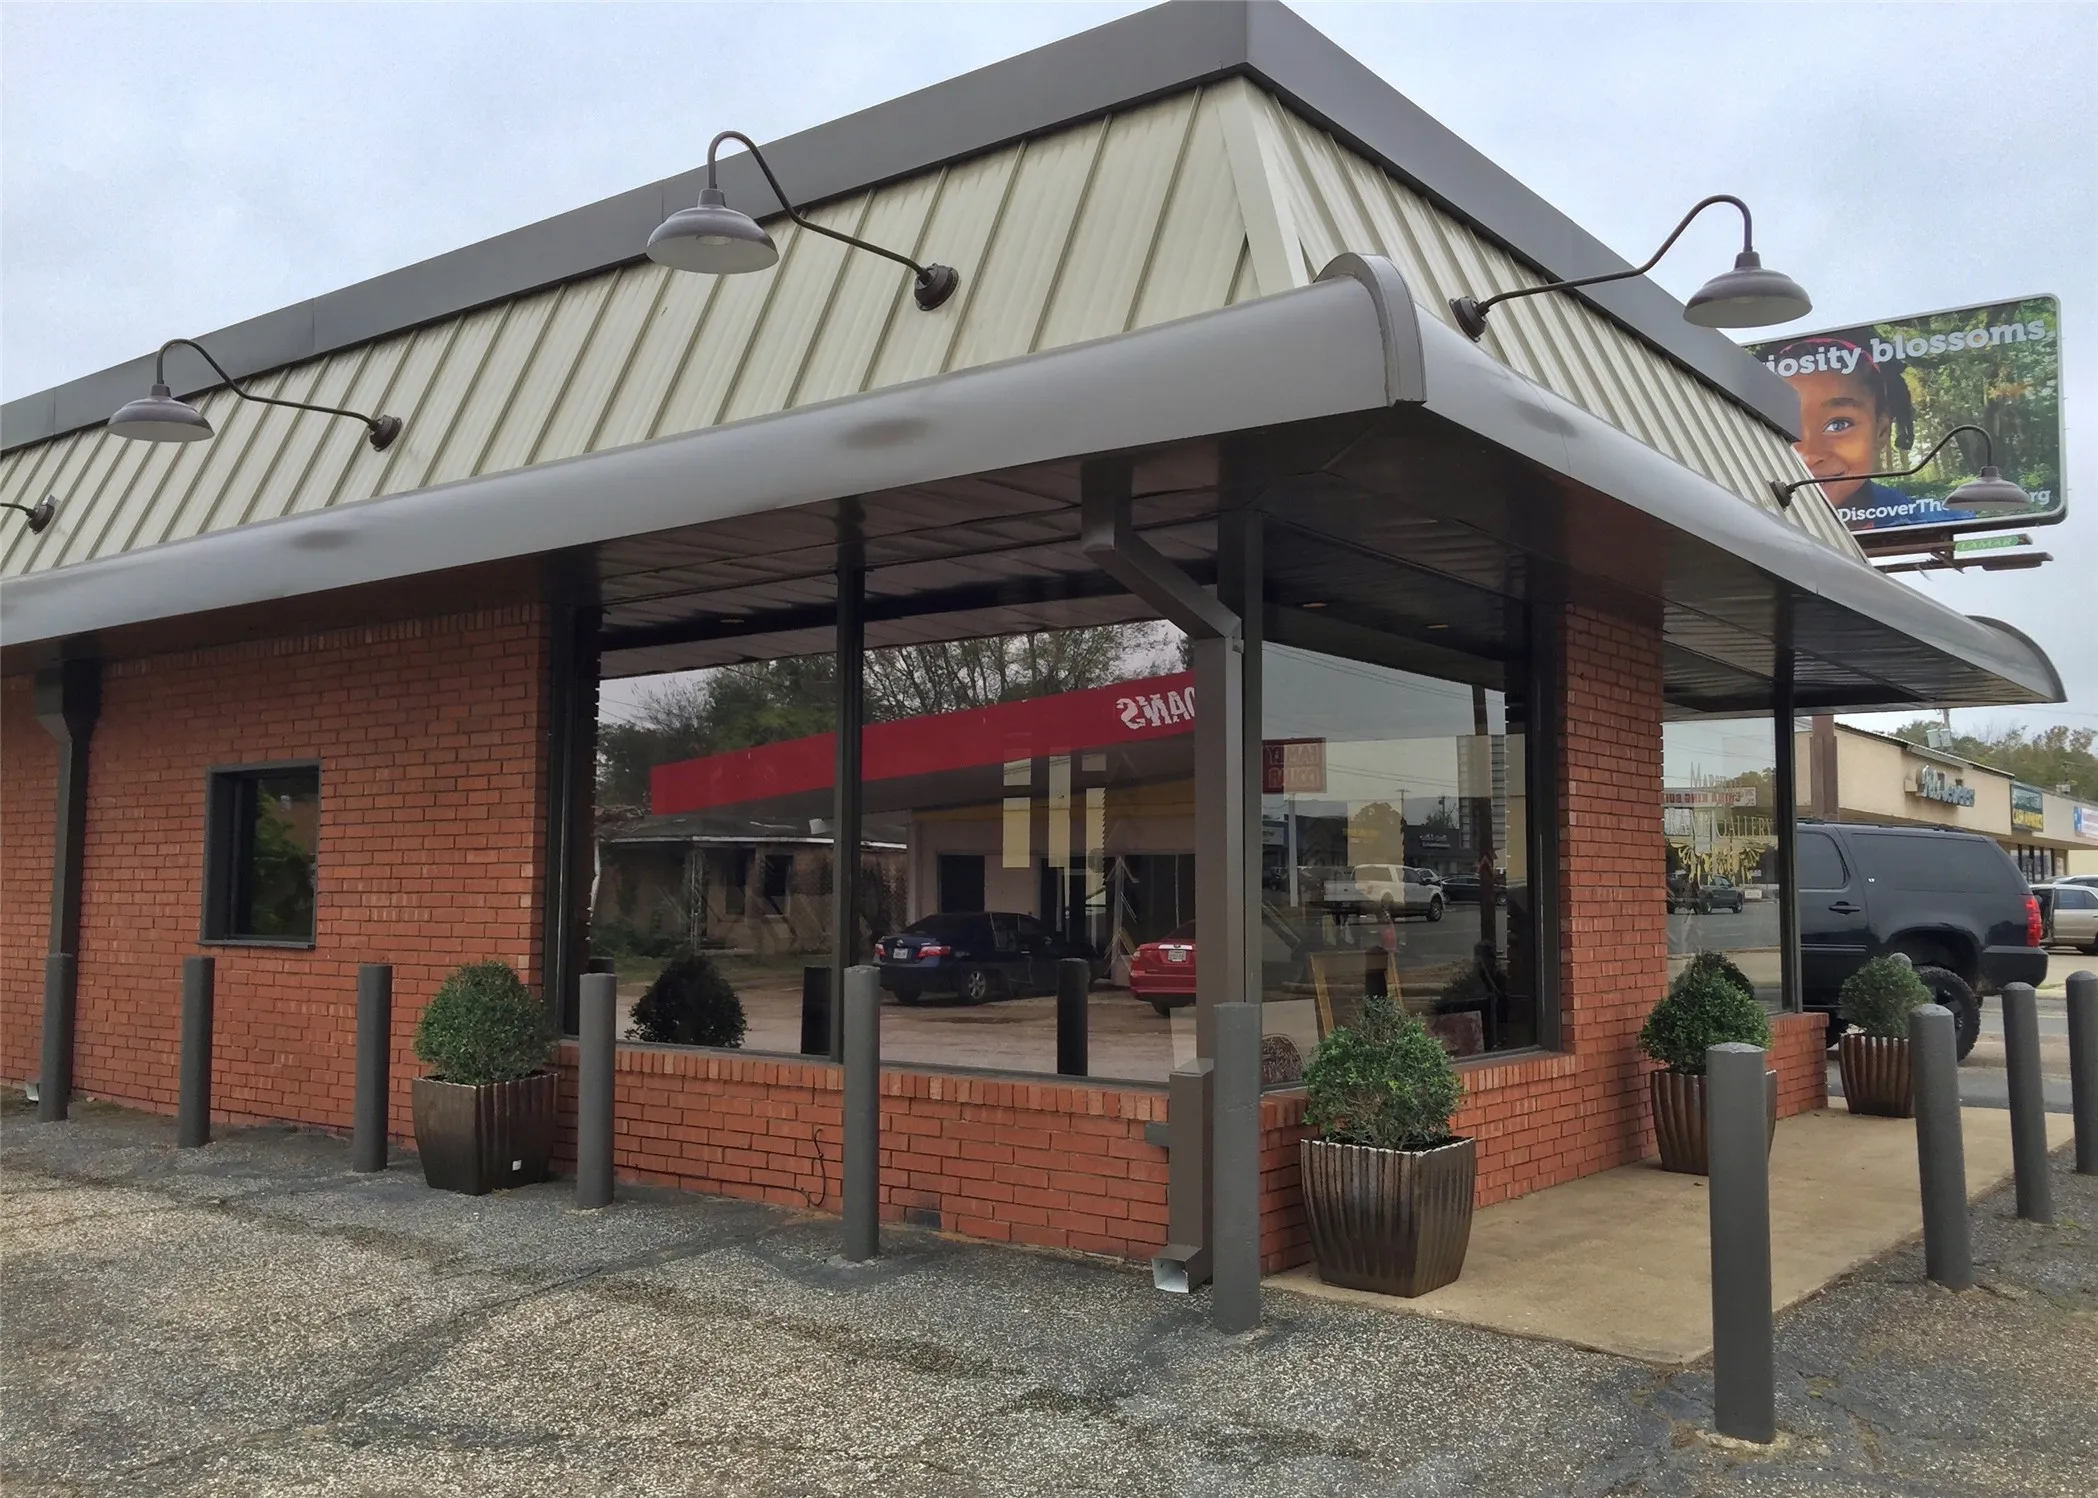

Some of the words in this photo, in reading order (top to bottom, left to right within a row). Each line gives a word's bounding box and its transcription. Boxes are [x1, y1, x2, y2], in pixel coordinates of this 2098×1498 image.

[1763, 346, 1861, 377] iosity
[1870, 319, 2056, 363] blossoms.
[1960, 538, 2013, 550] LAMAR
